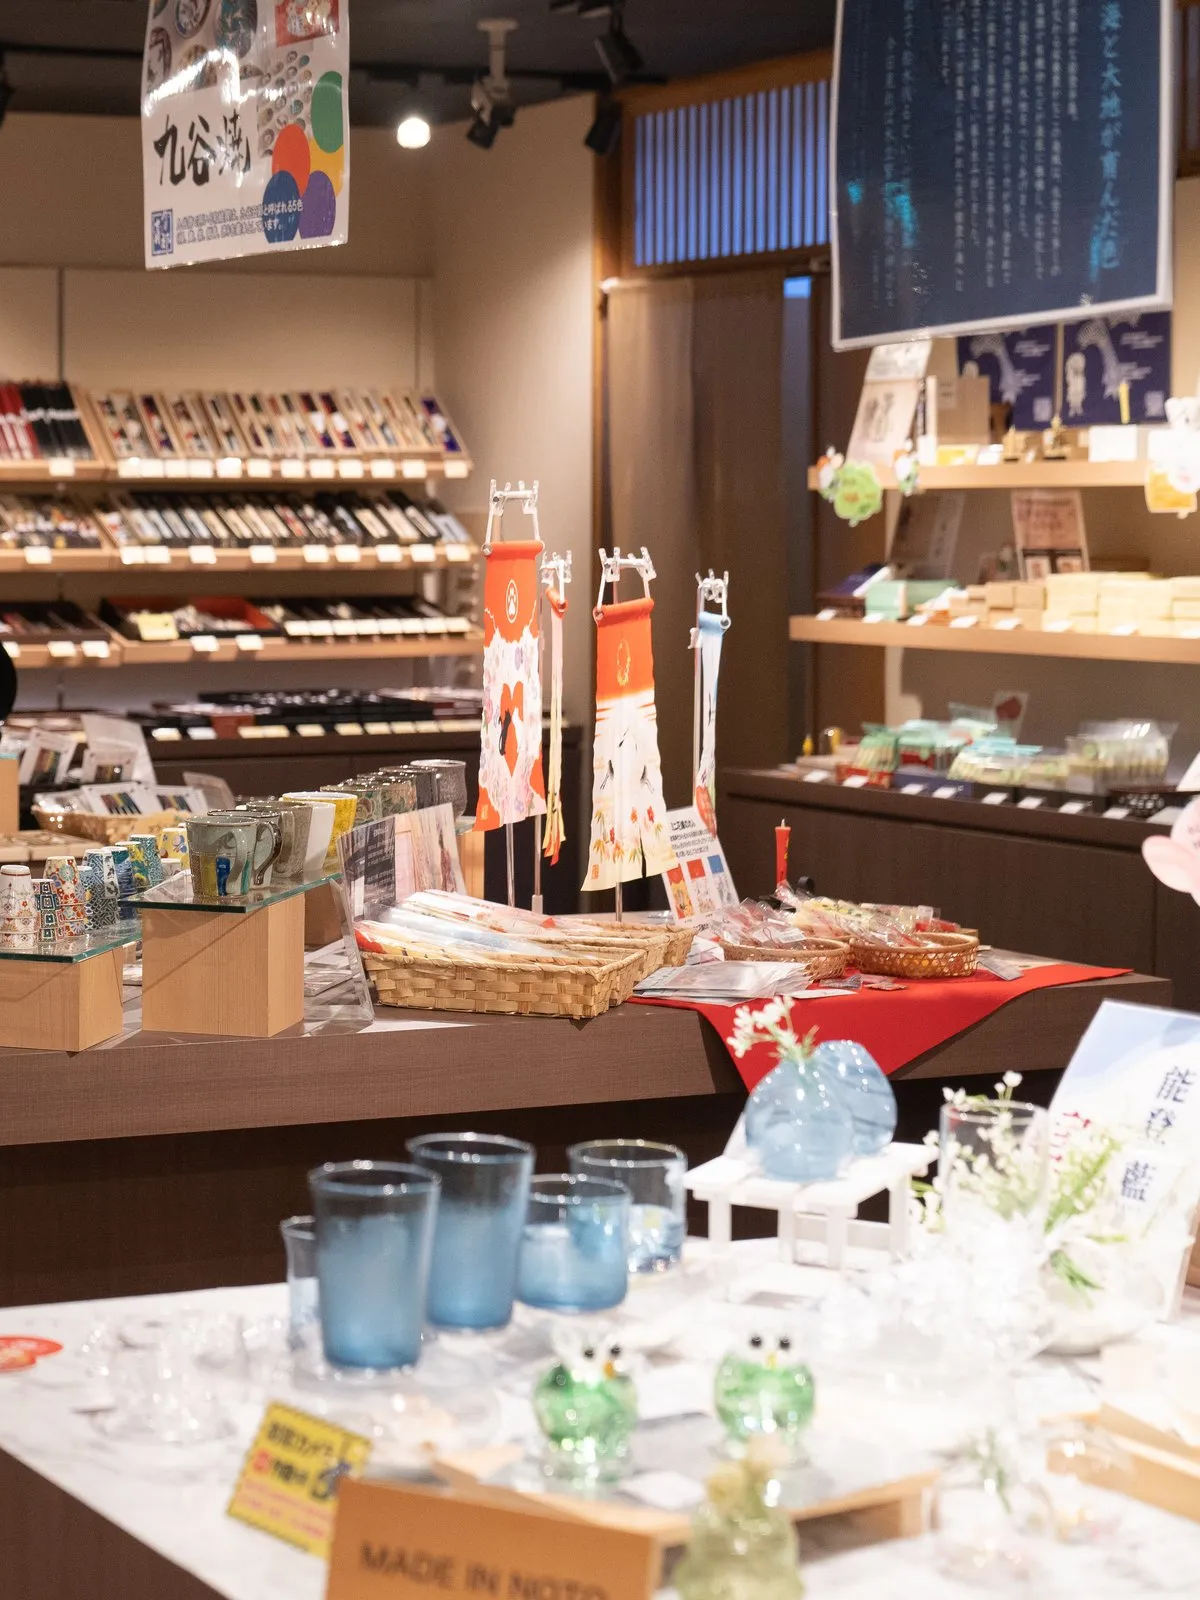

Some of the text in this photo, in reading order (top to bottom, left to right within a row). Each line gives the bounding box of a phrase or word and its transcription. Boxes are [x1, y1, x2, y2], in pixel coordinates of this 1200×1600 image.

[153, 108, 251, 186] 九谷焼
[1119, 1065, 1197, 1203] 能登藍
[359, 1540, 454, 1591] MADE
[463, 1561, 501, 1597] IN
